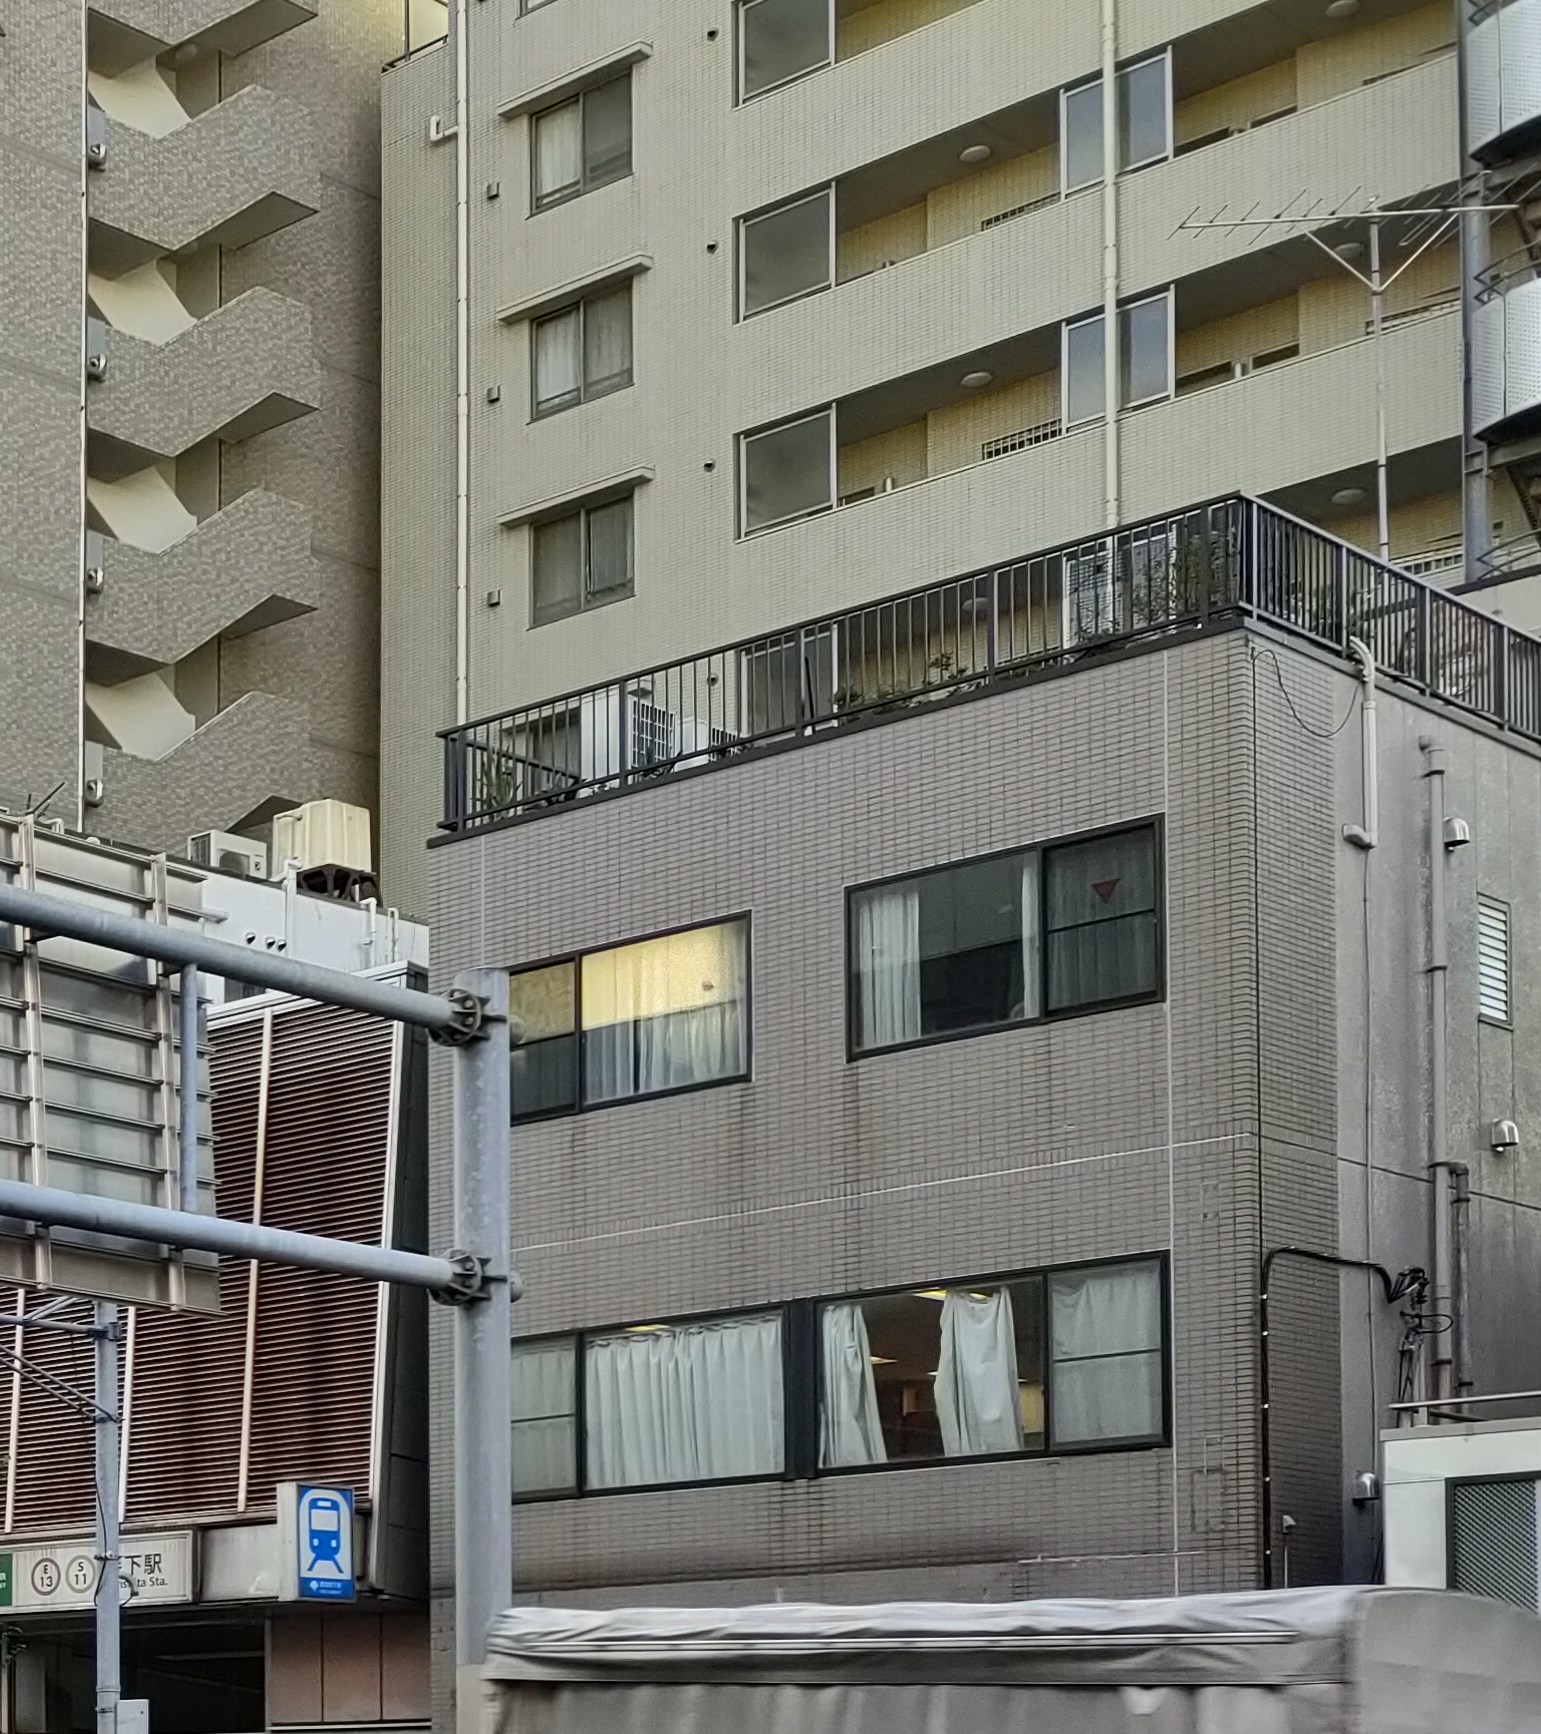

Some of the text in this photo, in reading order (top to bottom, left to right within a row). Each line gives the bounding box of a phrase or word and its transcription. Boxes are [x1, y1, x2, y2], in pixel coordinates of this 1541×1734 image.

[43, 1564, 49, 1575] E
[77, 1561, 84, 1573] S
[117, 1553, 162, 1576] 下駅
[40, 1575, 53, 1589] 13
[74, 1573, 88, 1586] 11
[149, 1576, 168, 1587] Sta.
